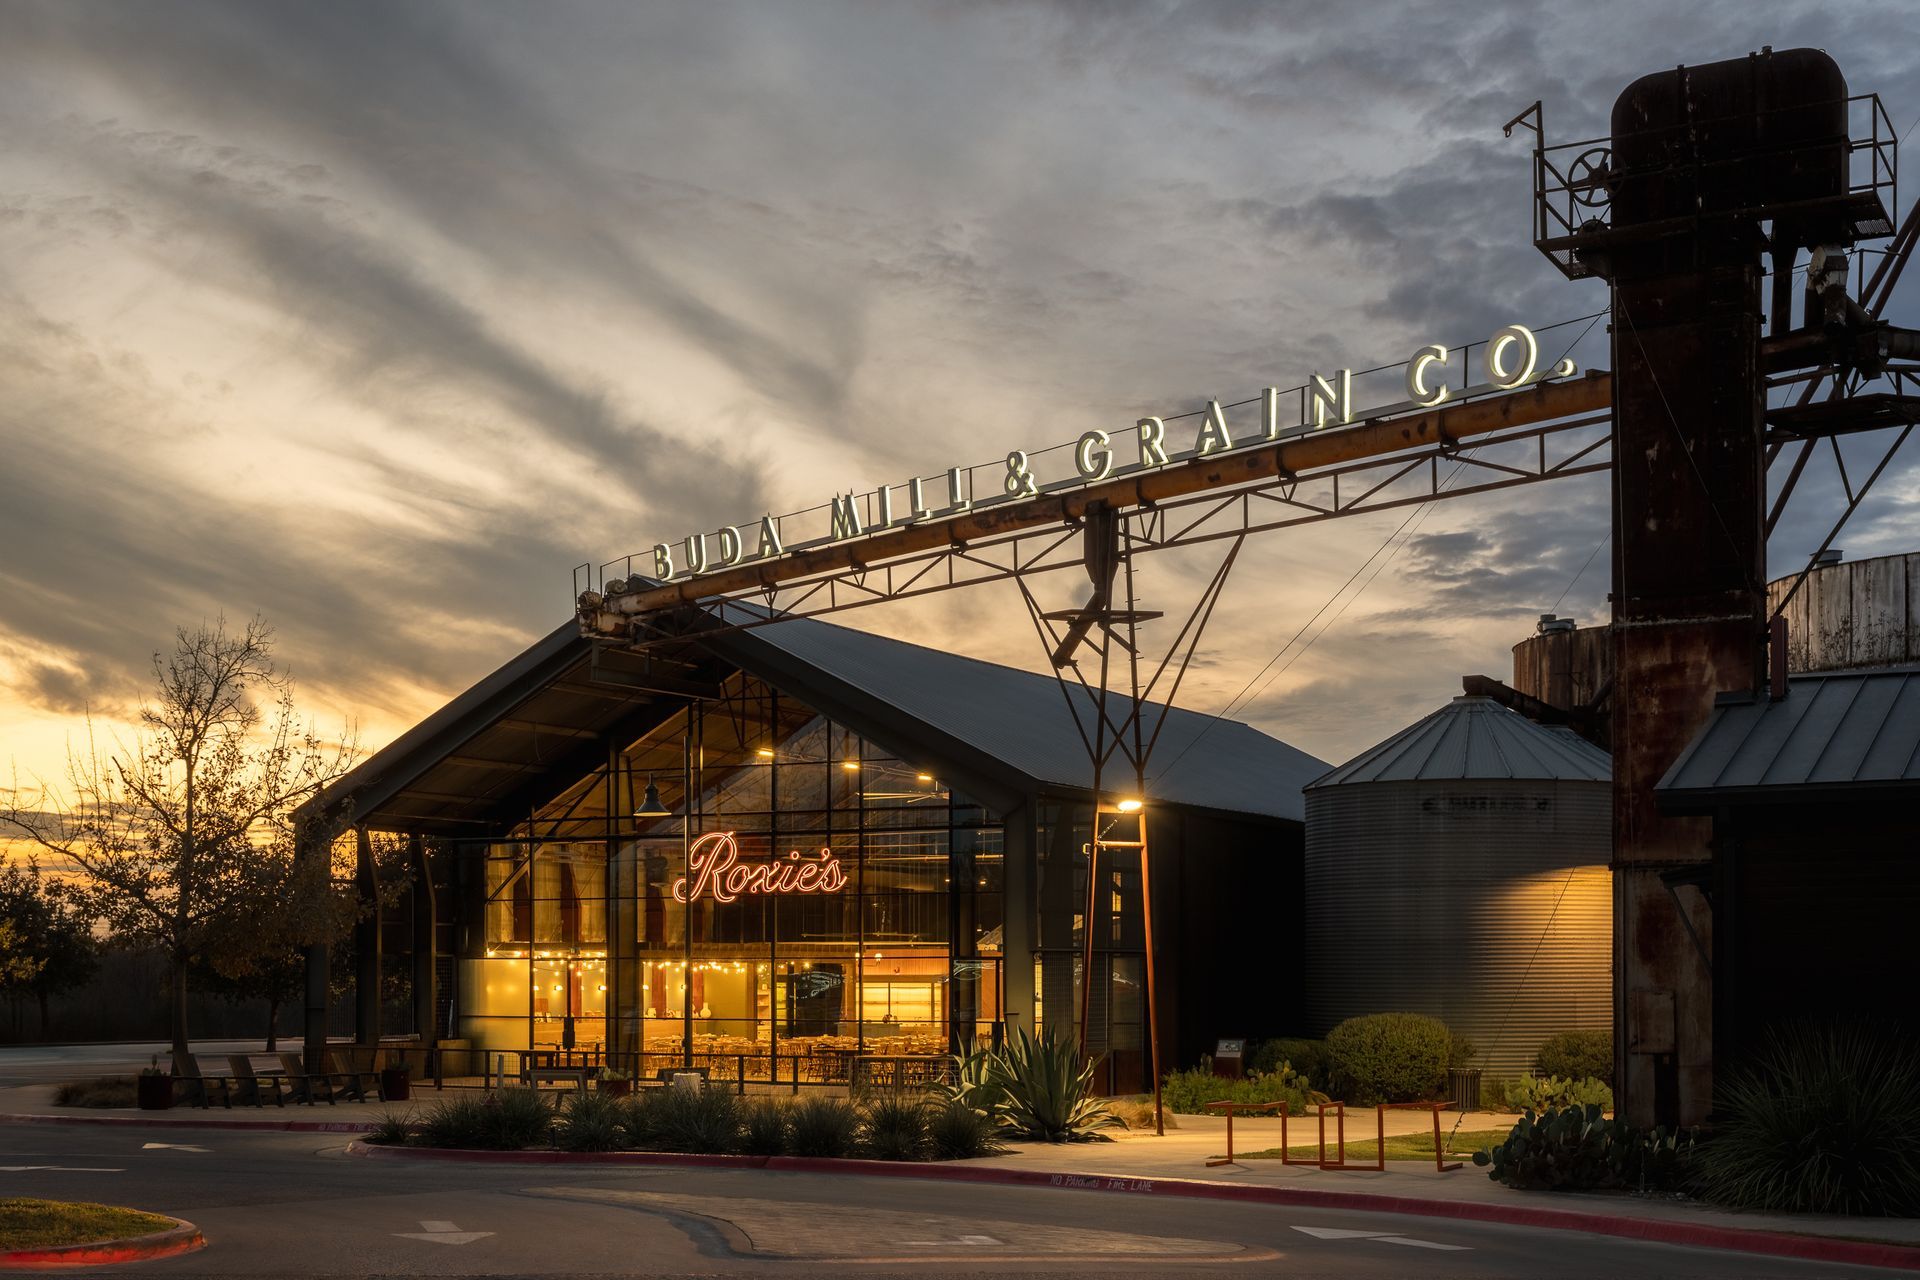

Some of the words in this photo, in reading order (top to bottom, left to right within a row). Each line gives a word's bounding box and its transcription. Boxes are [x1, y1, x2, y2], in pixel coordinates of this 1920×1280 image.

[653, 513, 784, 581] BUDA
[830, 466, 973, 539] MILL
[1004, 450, 1040, 499] &
[1074, 368, 1351, 481] GRAIN
[1405, 324, 1578, 407] CO.
[673, 830, 848, 904] Roxie's
[1049, 1174, 1062, 1186] NO
[1130, 1180, 1154, 1192] LANE
